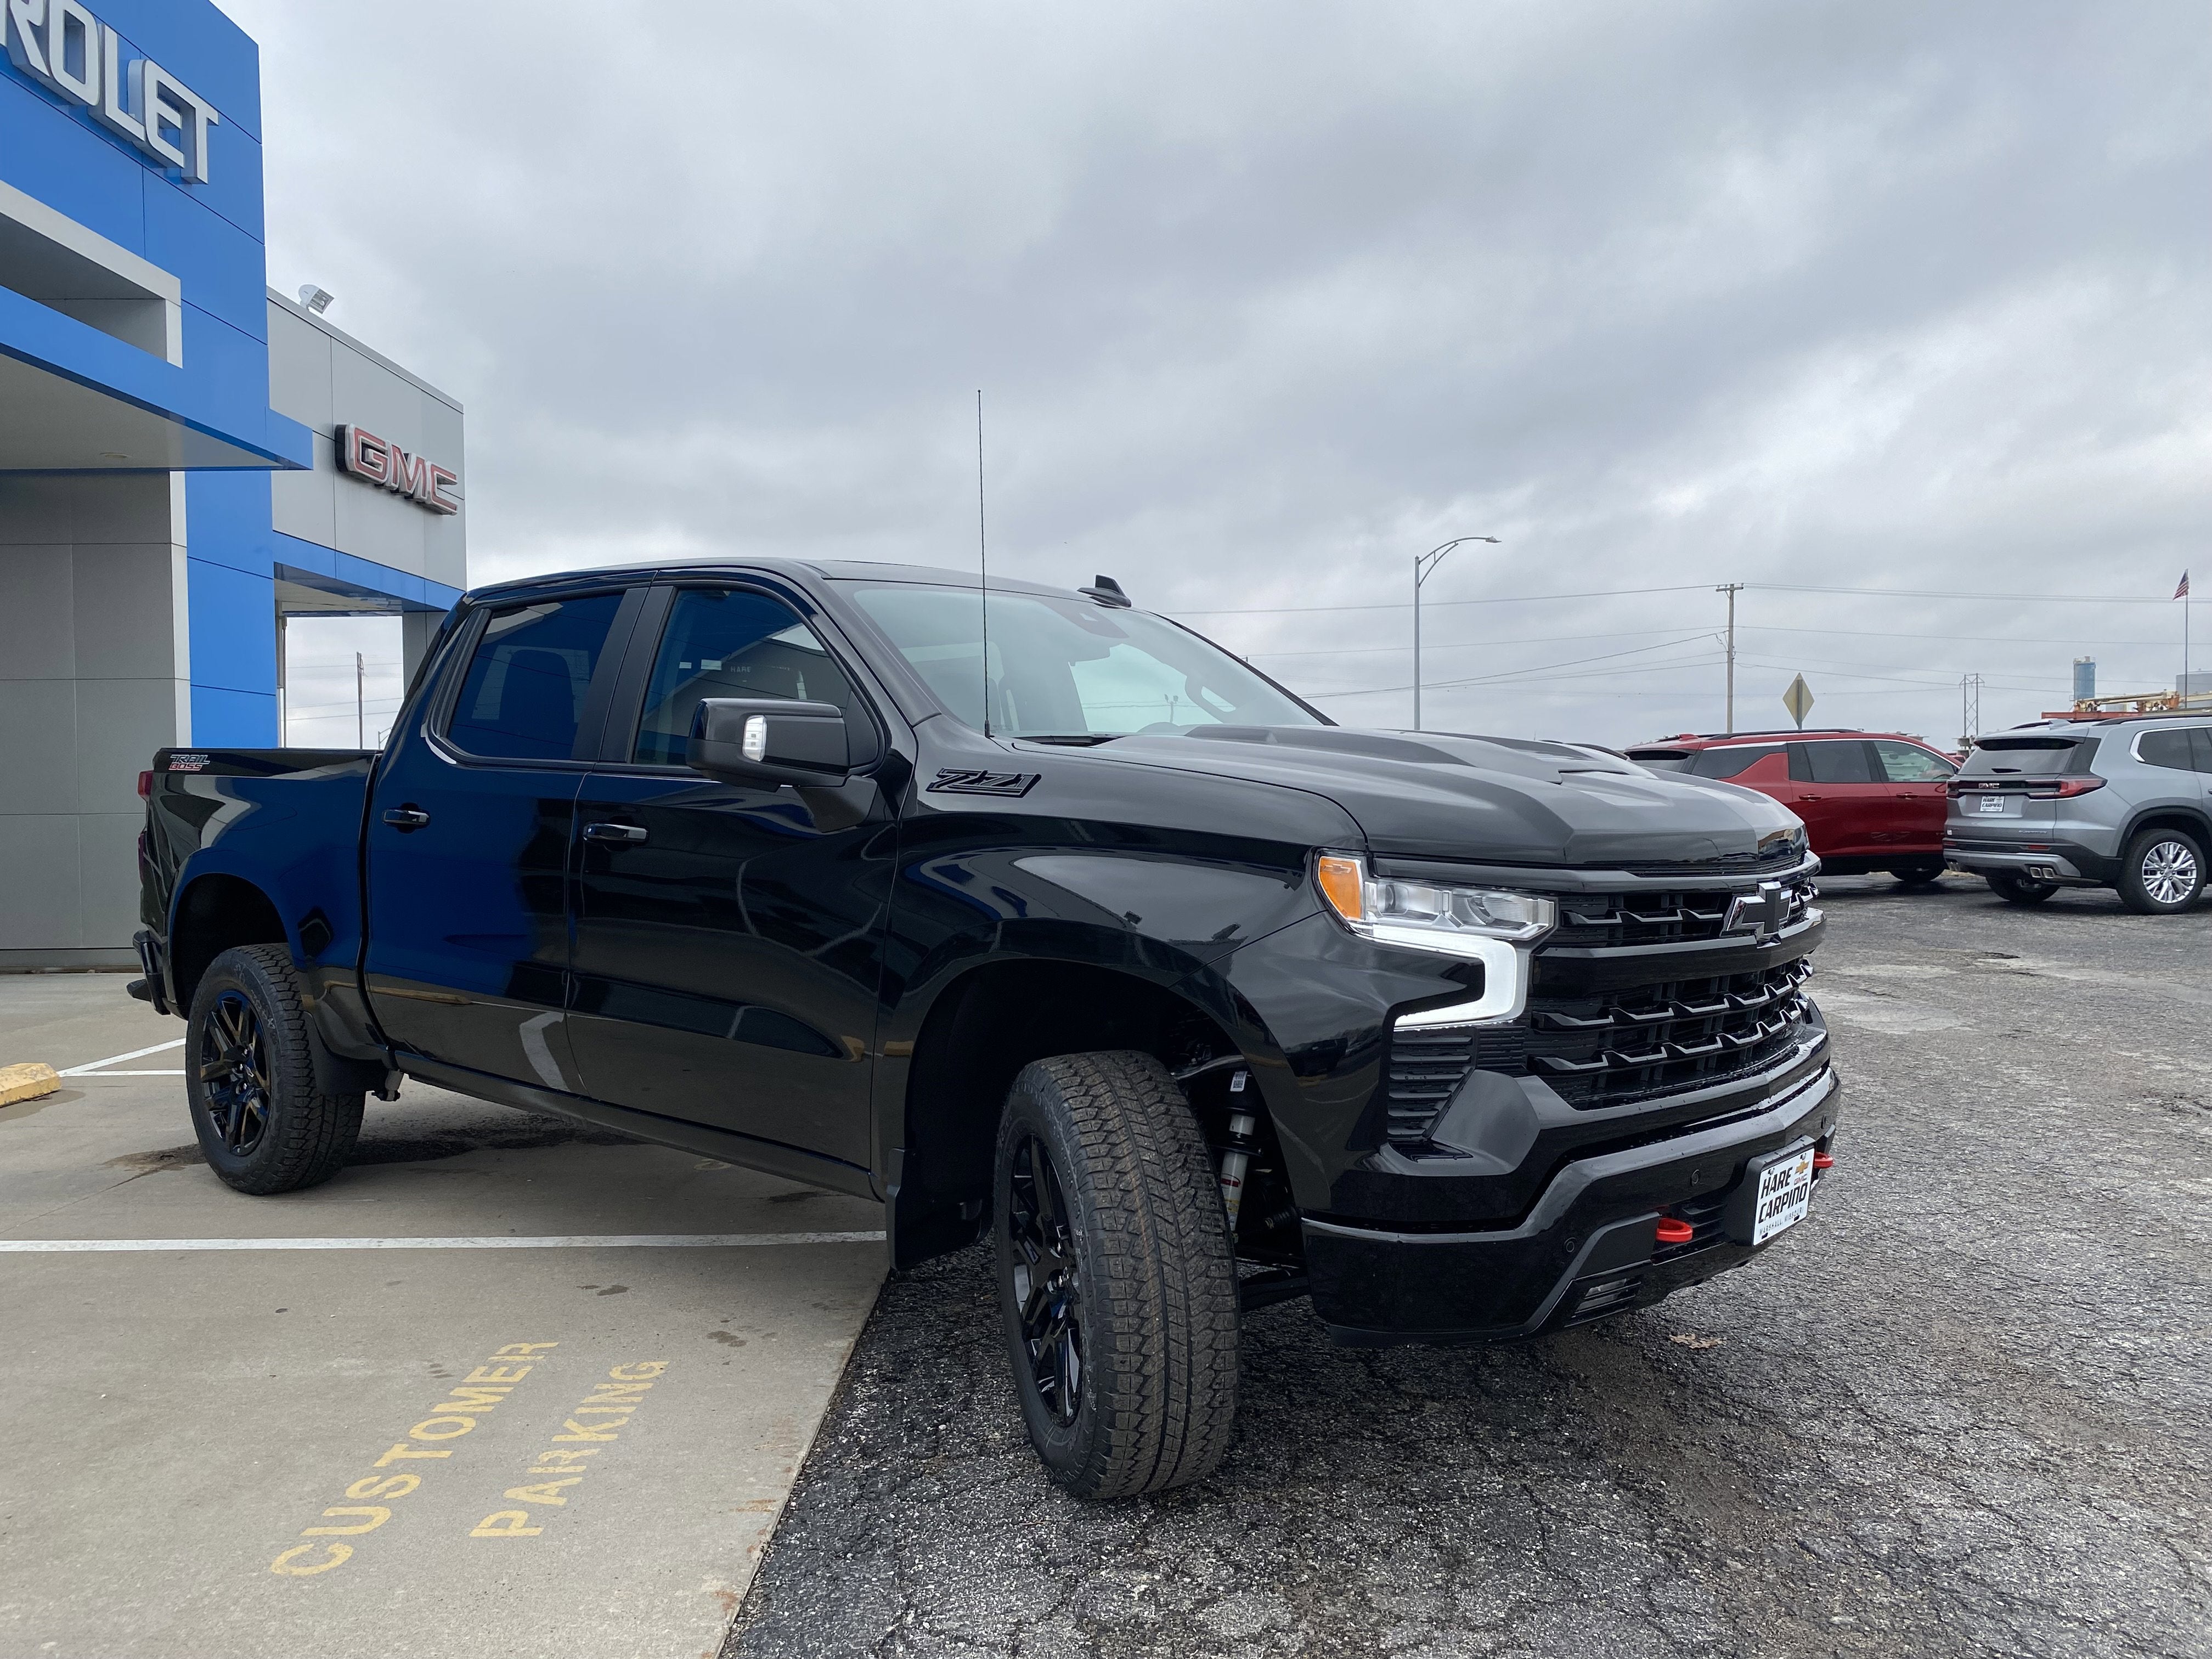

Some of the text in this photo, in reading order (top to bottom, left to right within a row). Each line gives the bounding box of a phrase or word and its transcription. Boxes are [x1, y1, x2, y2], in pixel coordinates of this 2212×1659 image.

[336, 423, 458, 516] GMC
[170, 754, 211, 764] TRAIL
[925, 768, 1042, 798] Z71
[1760, 1167, 1793, 1199] HARE
[1794, 1174, 1807, 1185] GMC
[1758, 1182, 1808, 1223] CARPINO
[270, 1341, 560, 1576] CUSTOMER
[469, 1361, 670, 1537] PARKING
